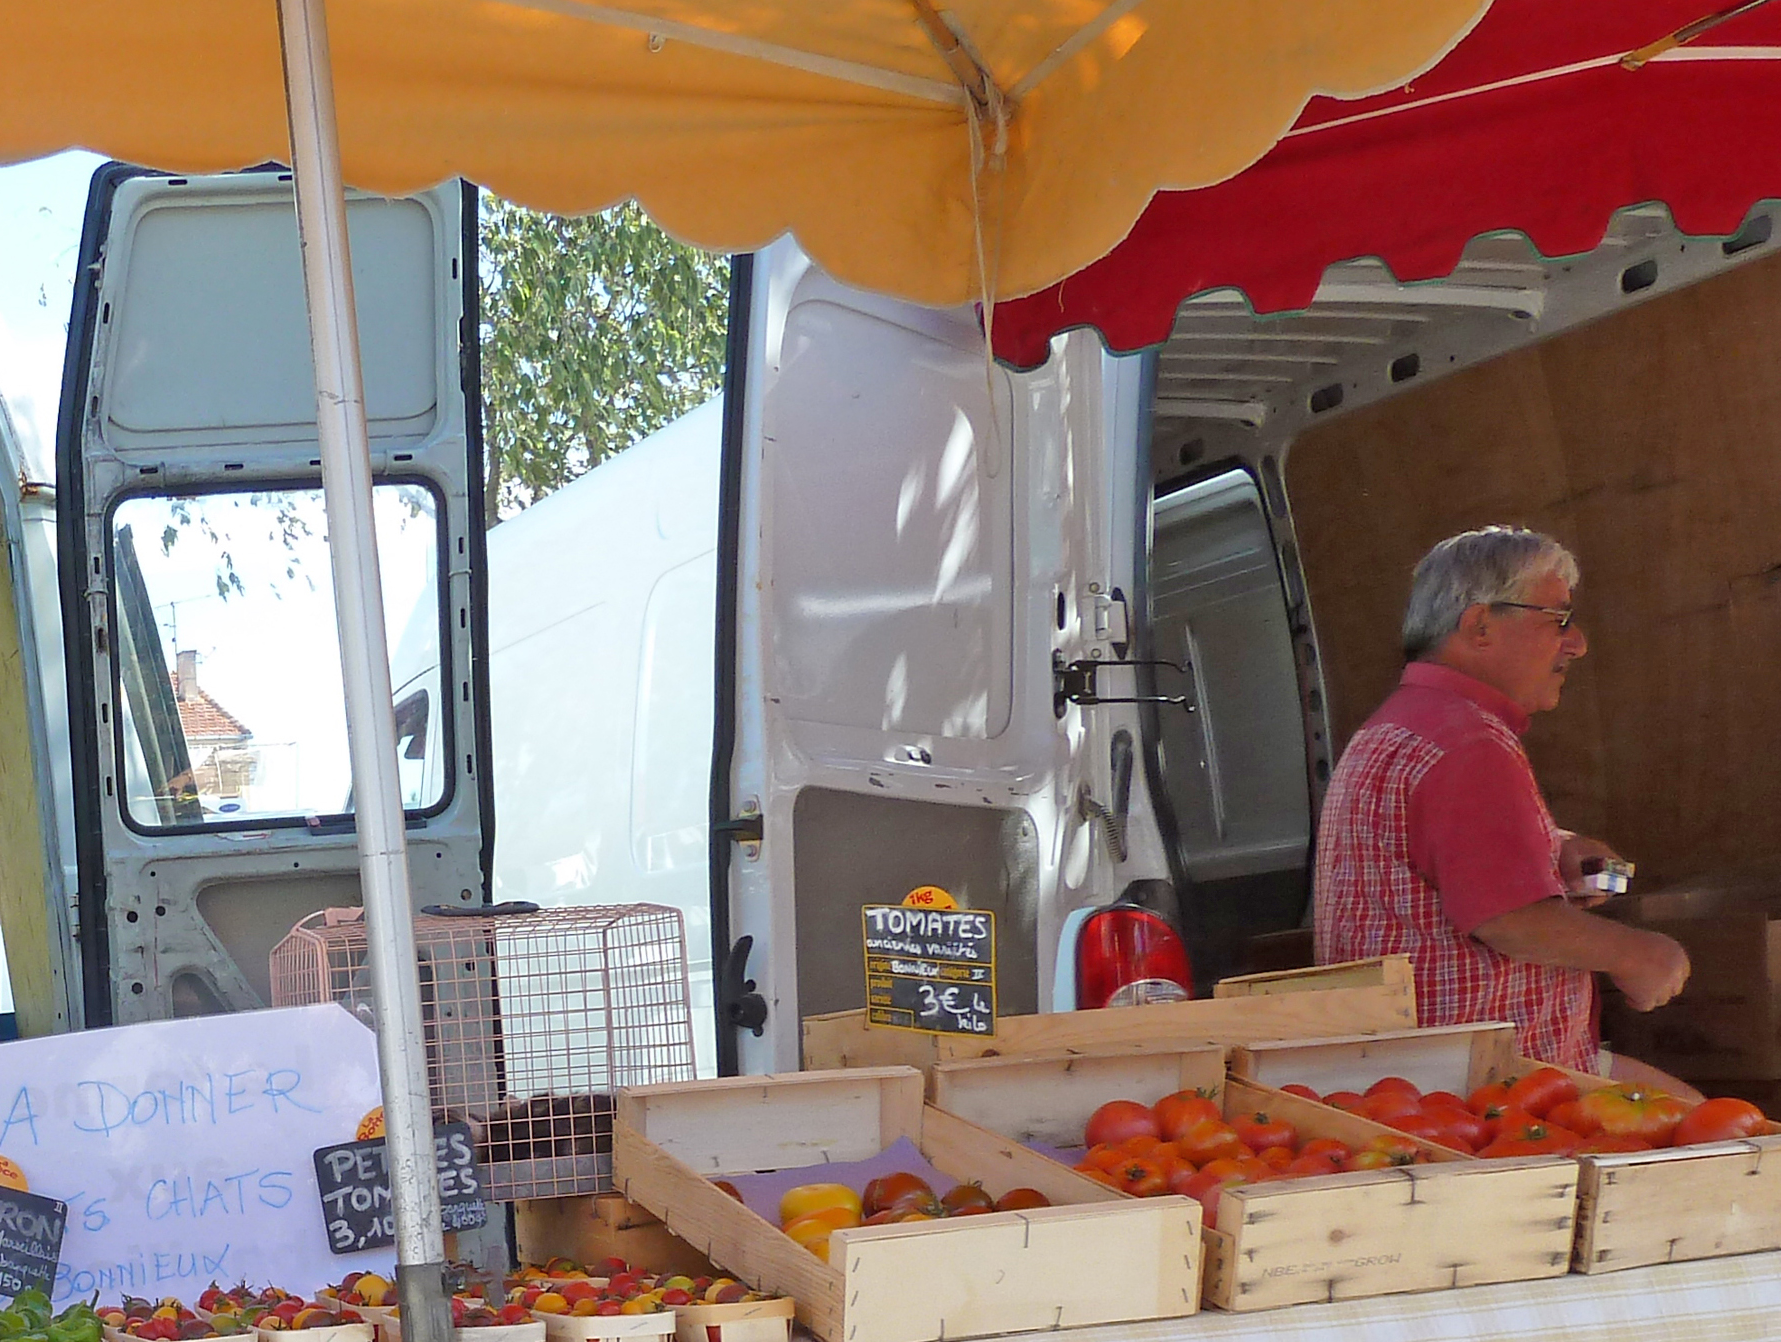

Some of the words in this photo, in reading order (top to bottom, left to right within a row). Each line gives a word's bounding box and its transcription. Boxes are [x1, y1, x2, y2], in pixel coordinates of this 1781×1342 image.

[865, 908, 987, 939] TOMATES
[73, 1068, 323, 1137] DONNER
[145, 1168, 294, 1221] CHATS
